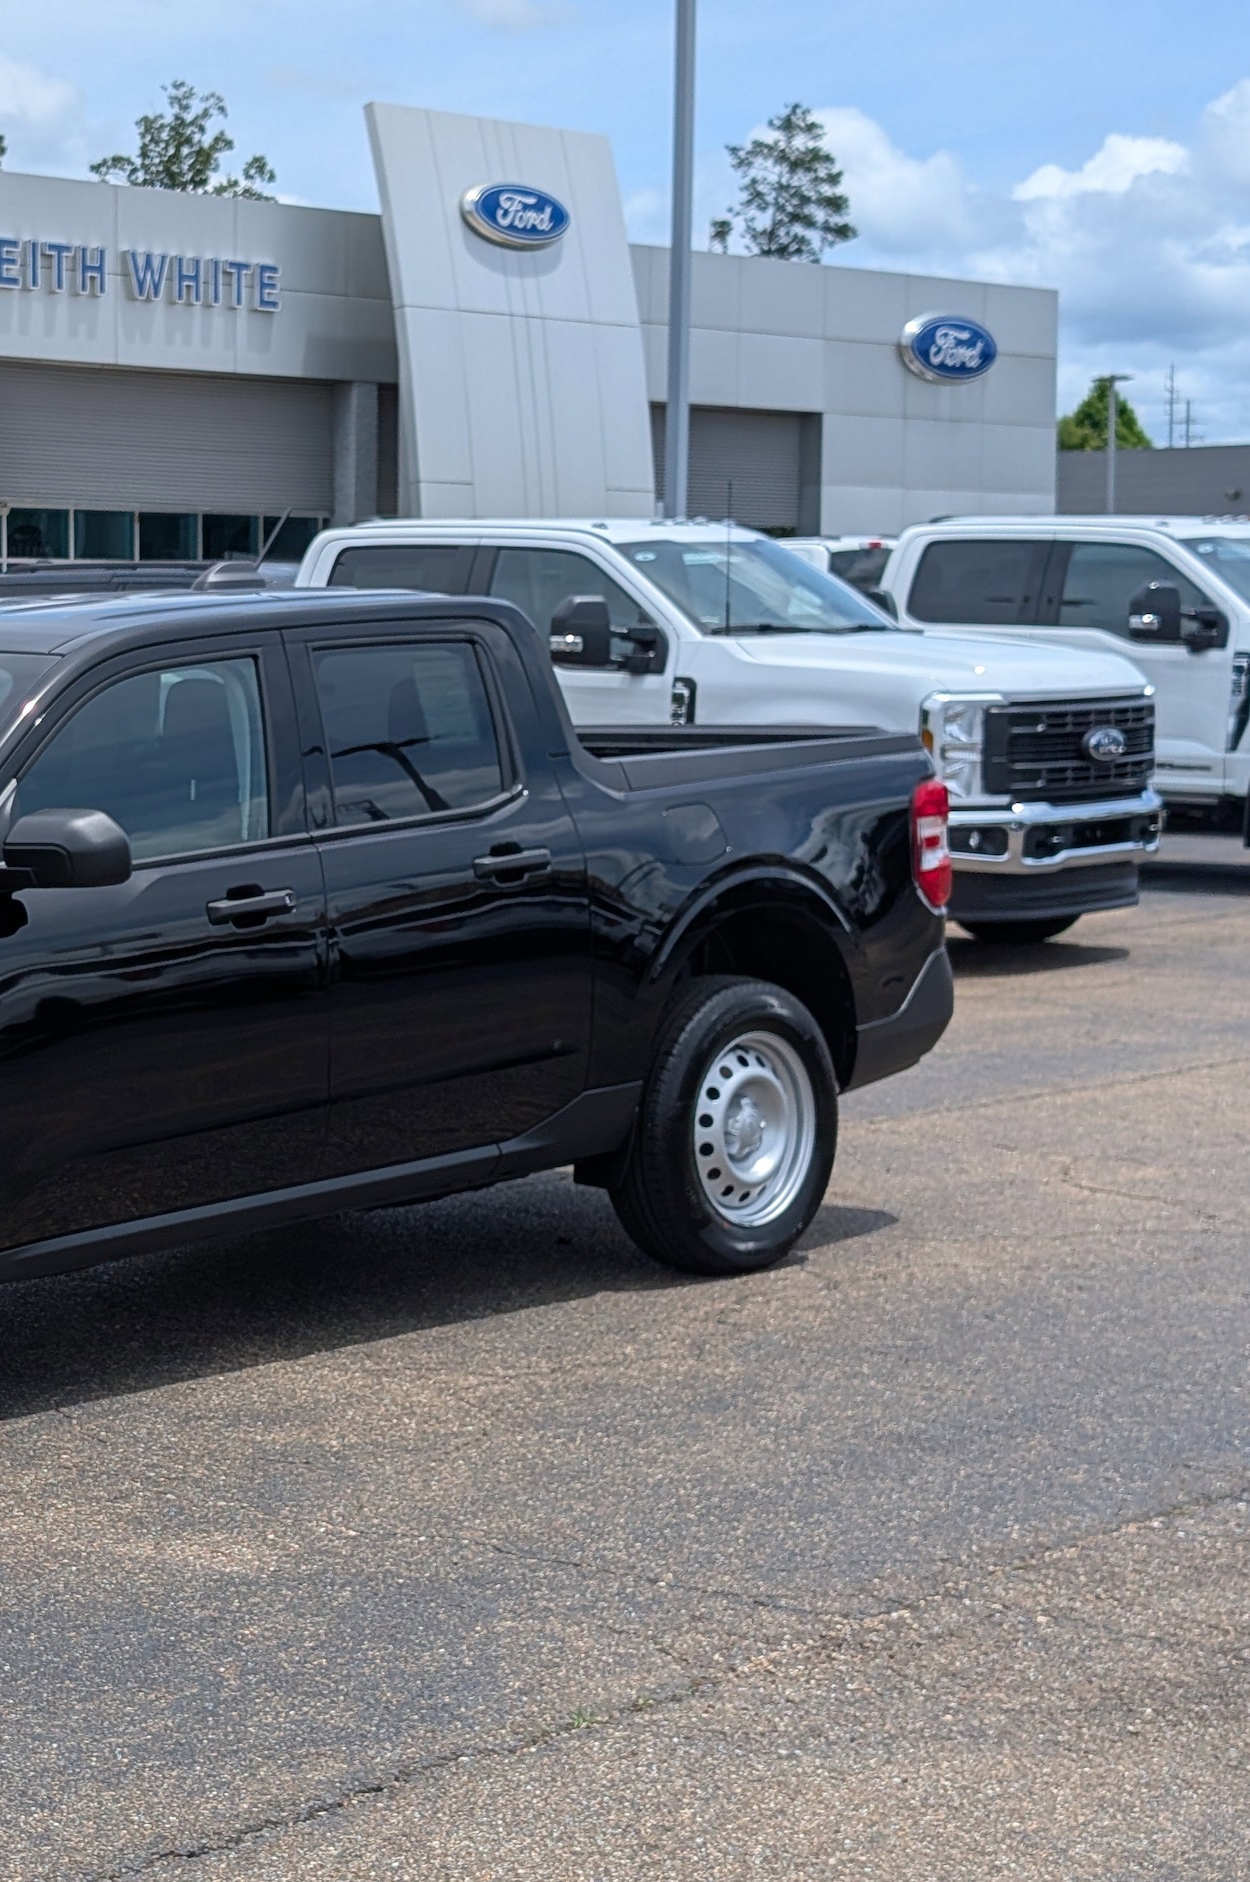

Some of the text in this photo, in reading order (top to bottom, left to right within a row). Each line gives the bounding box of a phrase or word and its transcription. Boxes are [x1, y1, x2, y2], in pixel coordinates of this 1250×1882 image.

[496, 191, 554, 232] Ford
[125, 250, 281, 312] WHITE
[930, 325, 985, 368] Ford
